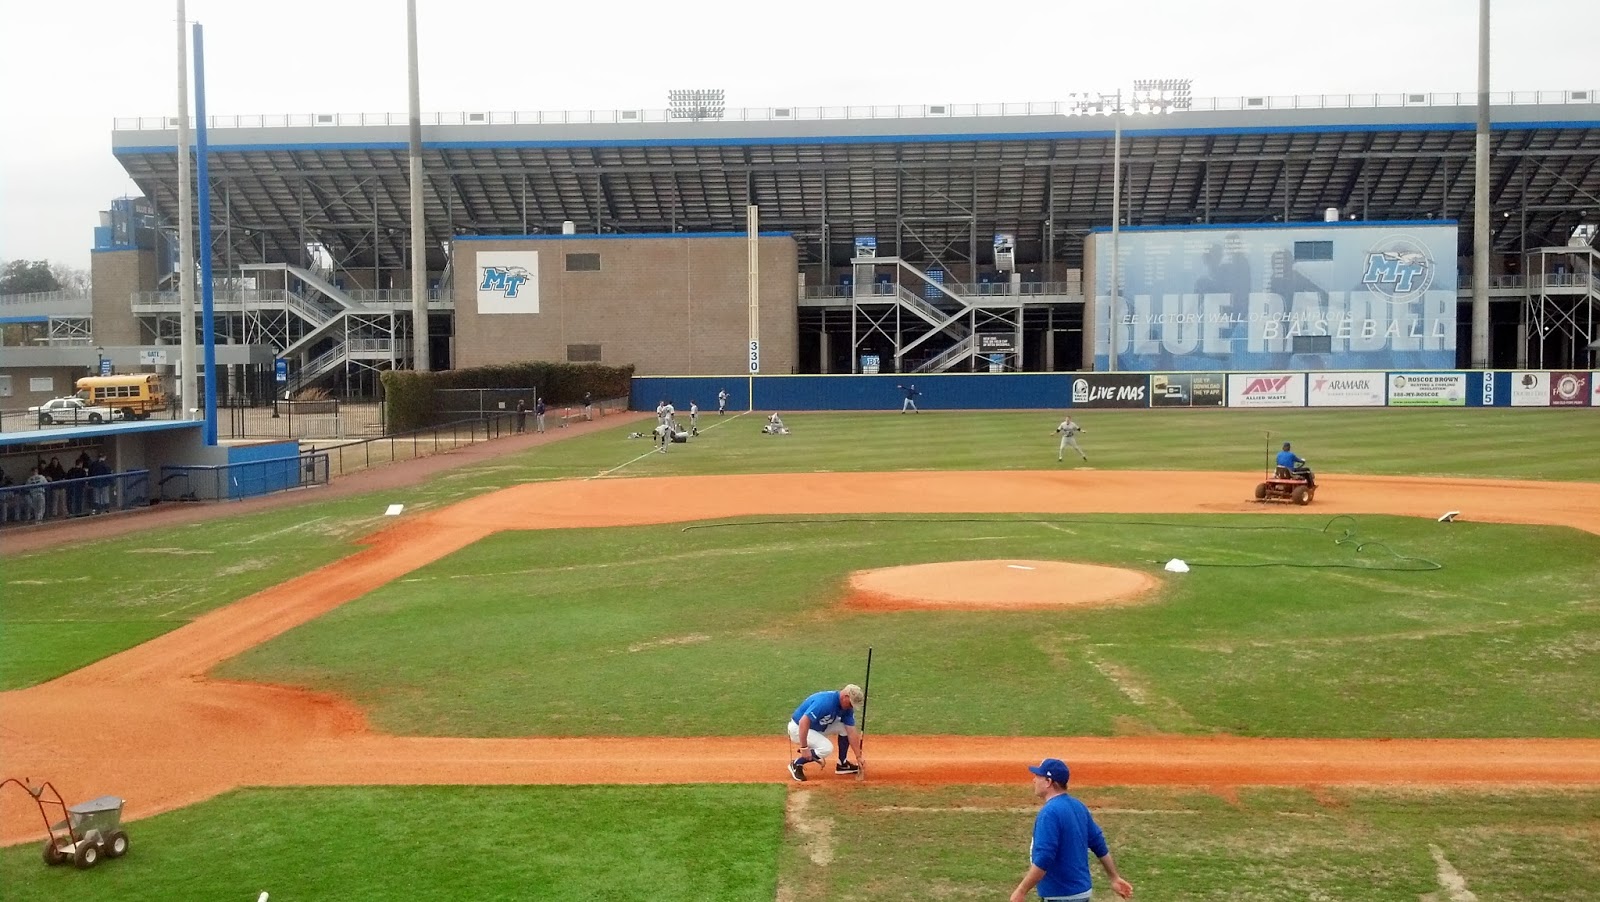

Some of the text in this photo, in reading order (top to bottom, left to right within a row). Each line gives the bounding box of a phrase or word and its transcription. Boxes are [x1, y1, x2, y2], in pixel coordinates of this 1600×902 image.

[479, 266, 527, 298] MT
[1362, 252, 1424, 293] MT
[1095, 289, 1457, 355] BLUE RAIDER
[1144, 312, 1203, 324] VICTORY
[1208, 312, 1244, 323] WALL
[1250, 312, 1269, 322] OF
[1272, 310, 1353, 323] CHAMPIONS
[1262, 317, 1447, 340] BASEBALL
[750, 341, 758, 371] 330
[1328, 380, 1370, 390] ARAMARK
[1484, 372, 1492, 403] 365
